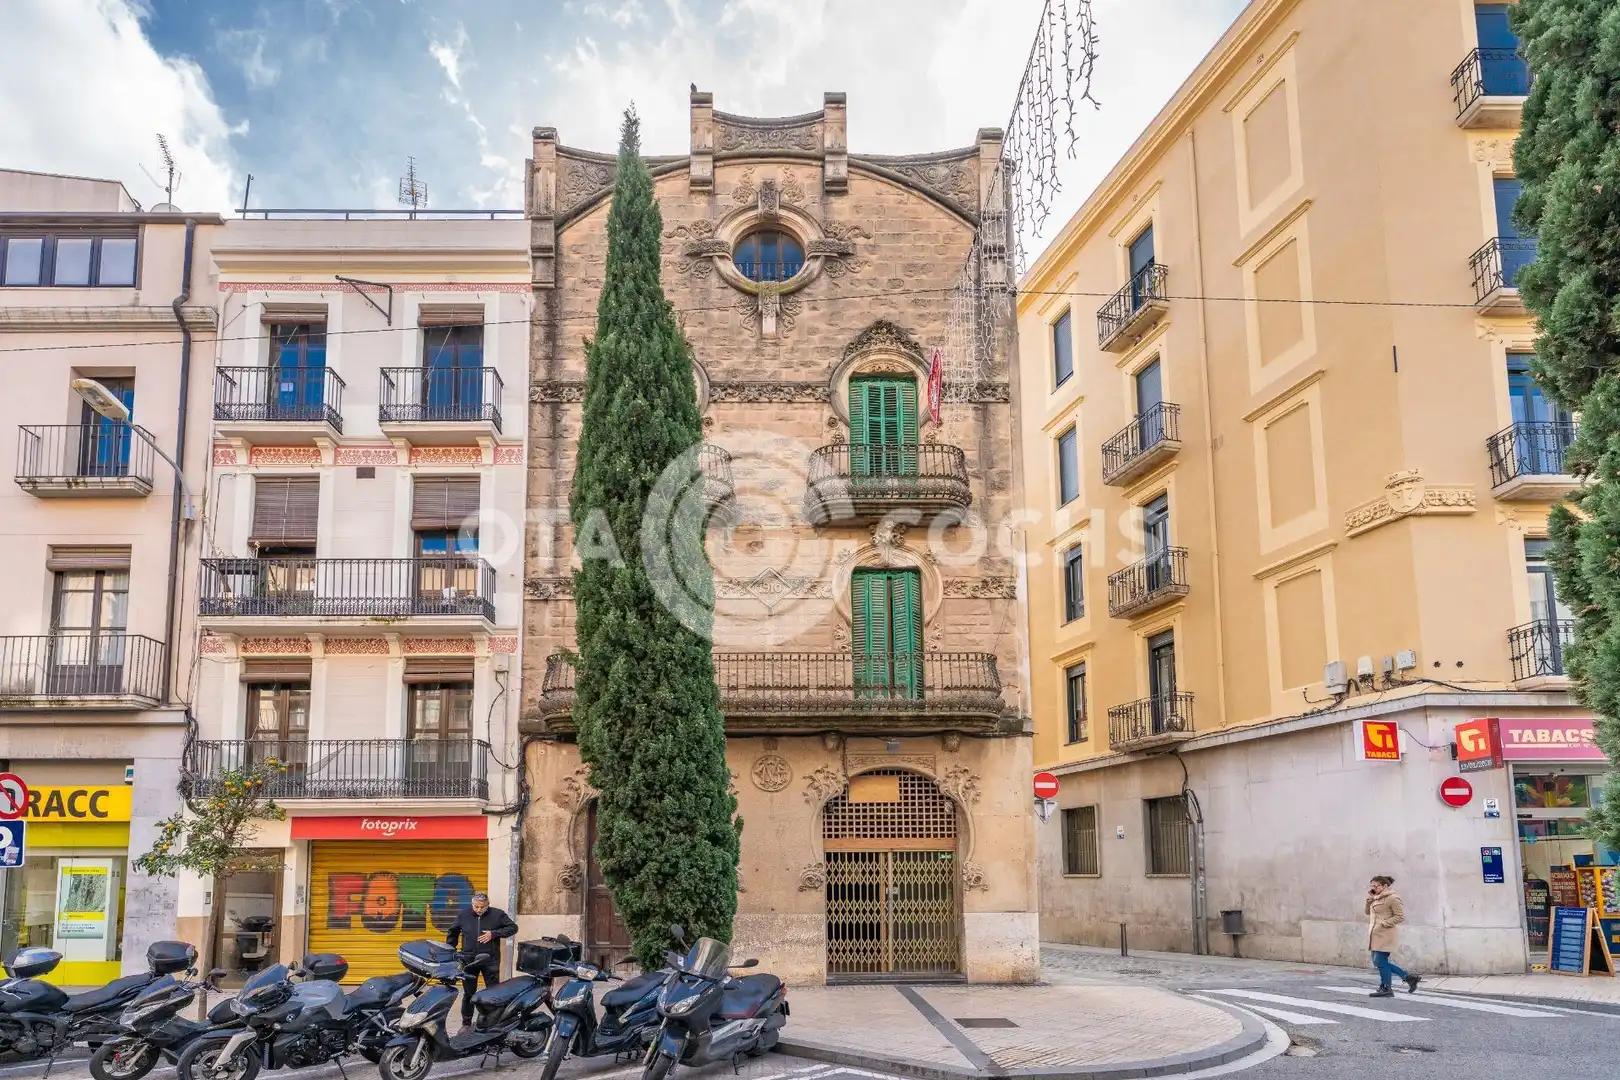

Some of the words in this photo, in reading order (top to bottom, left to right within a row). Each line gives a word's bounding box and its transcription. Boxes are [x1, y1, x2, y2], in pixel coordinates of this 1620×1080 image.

[1509, 729, 1595, 743] TABACS
[1366, 751, 1397, 759] TABACS
[23, 790, 110, 818] RACC
[361, 818, 418, 832] fotoprix
[327, 871, 475, 933] FOTO
